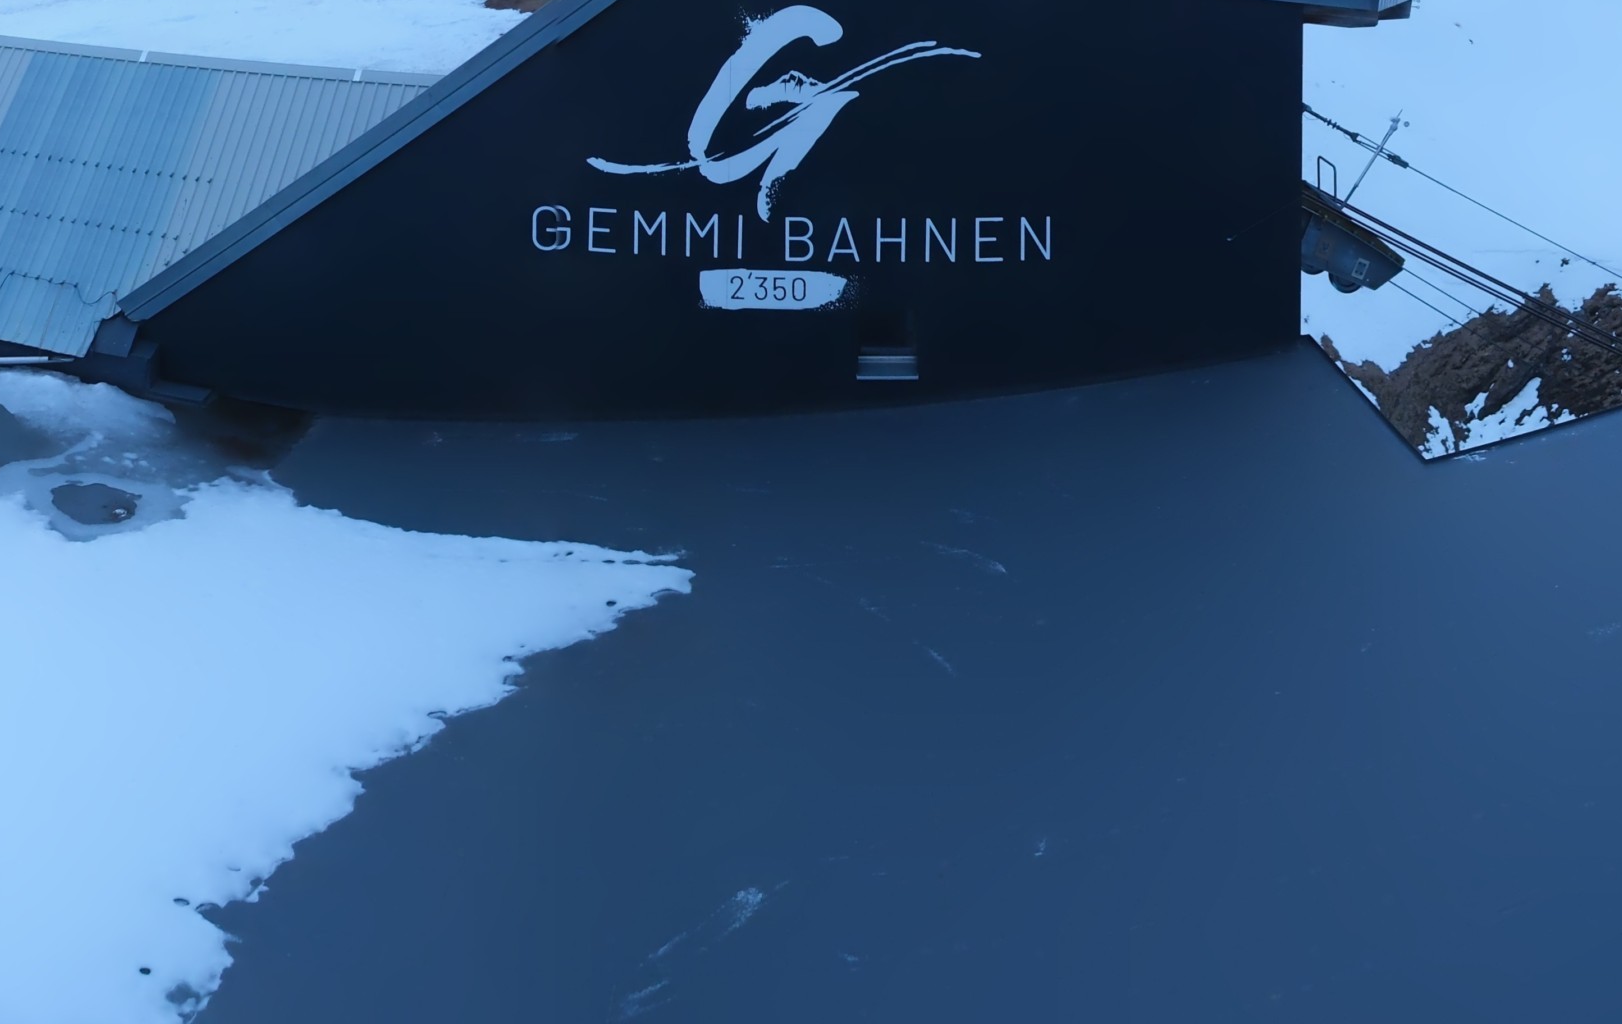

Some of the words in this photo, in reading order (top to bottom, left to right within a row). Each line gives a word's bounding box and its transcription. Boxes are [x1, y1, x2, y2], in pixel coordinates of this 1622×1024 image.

[531, 204, 744, 260] GEMMI
[784, 215, 1052, 263] BAHNEN
[729, 271, 808, 302] 2'350
